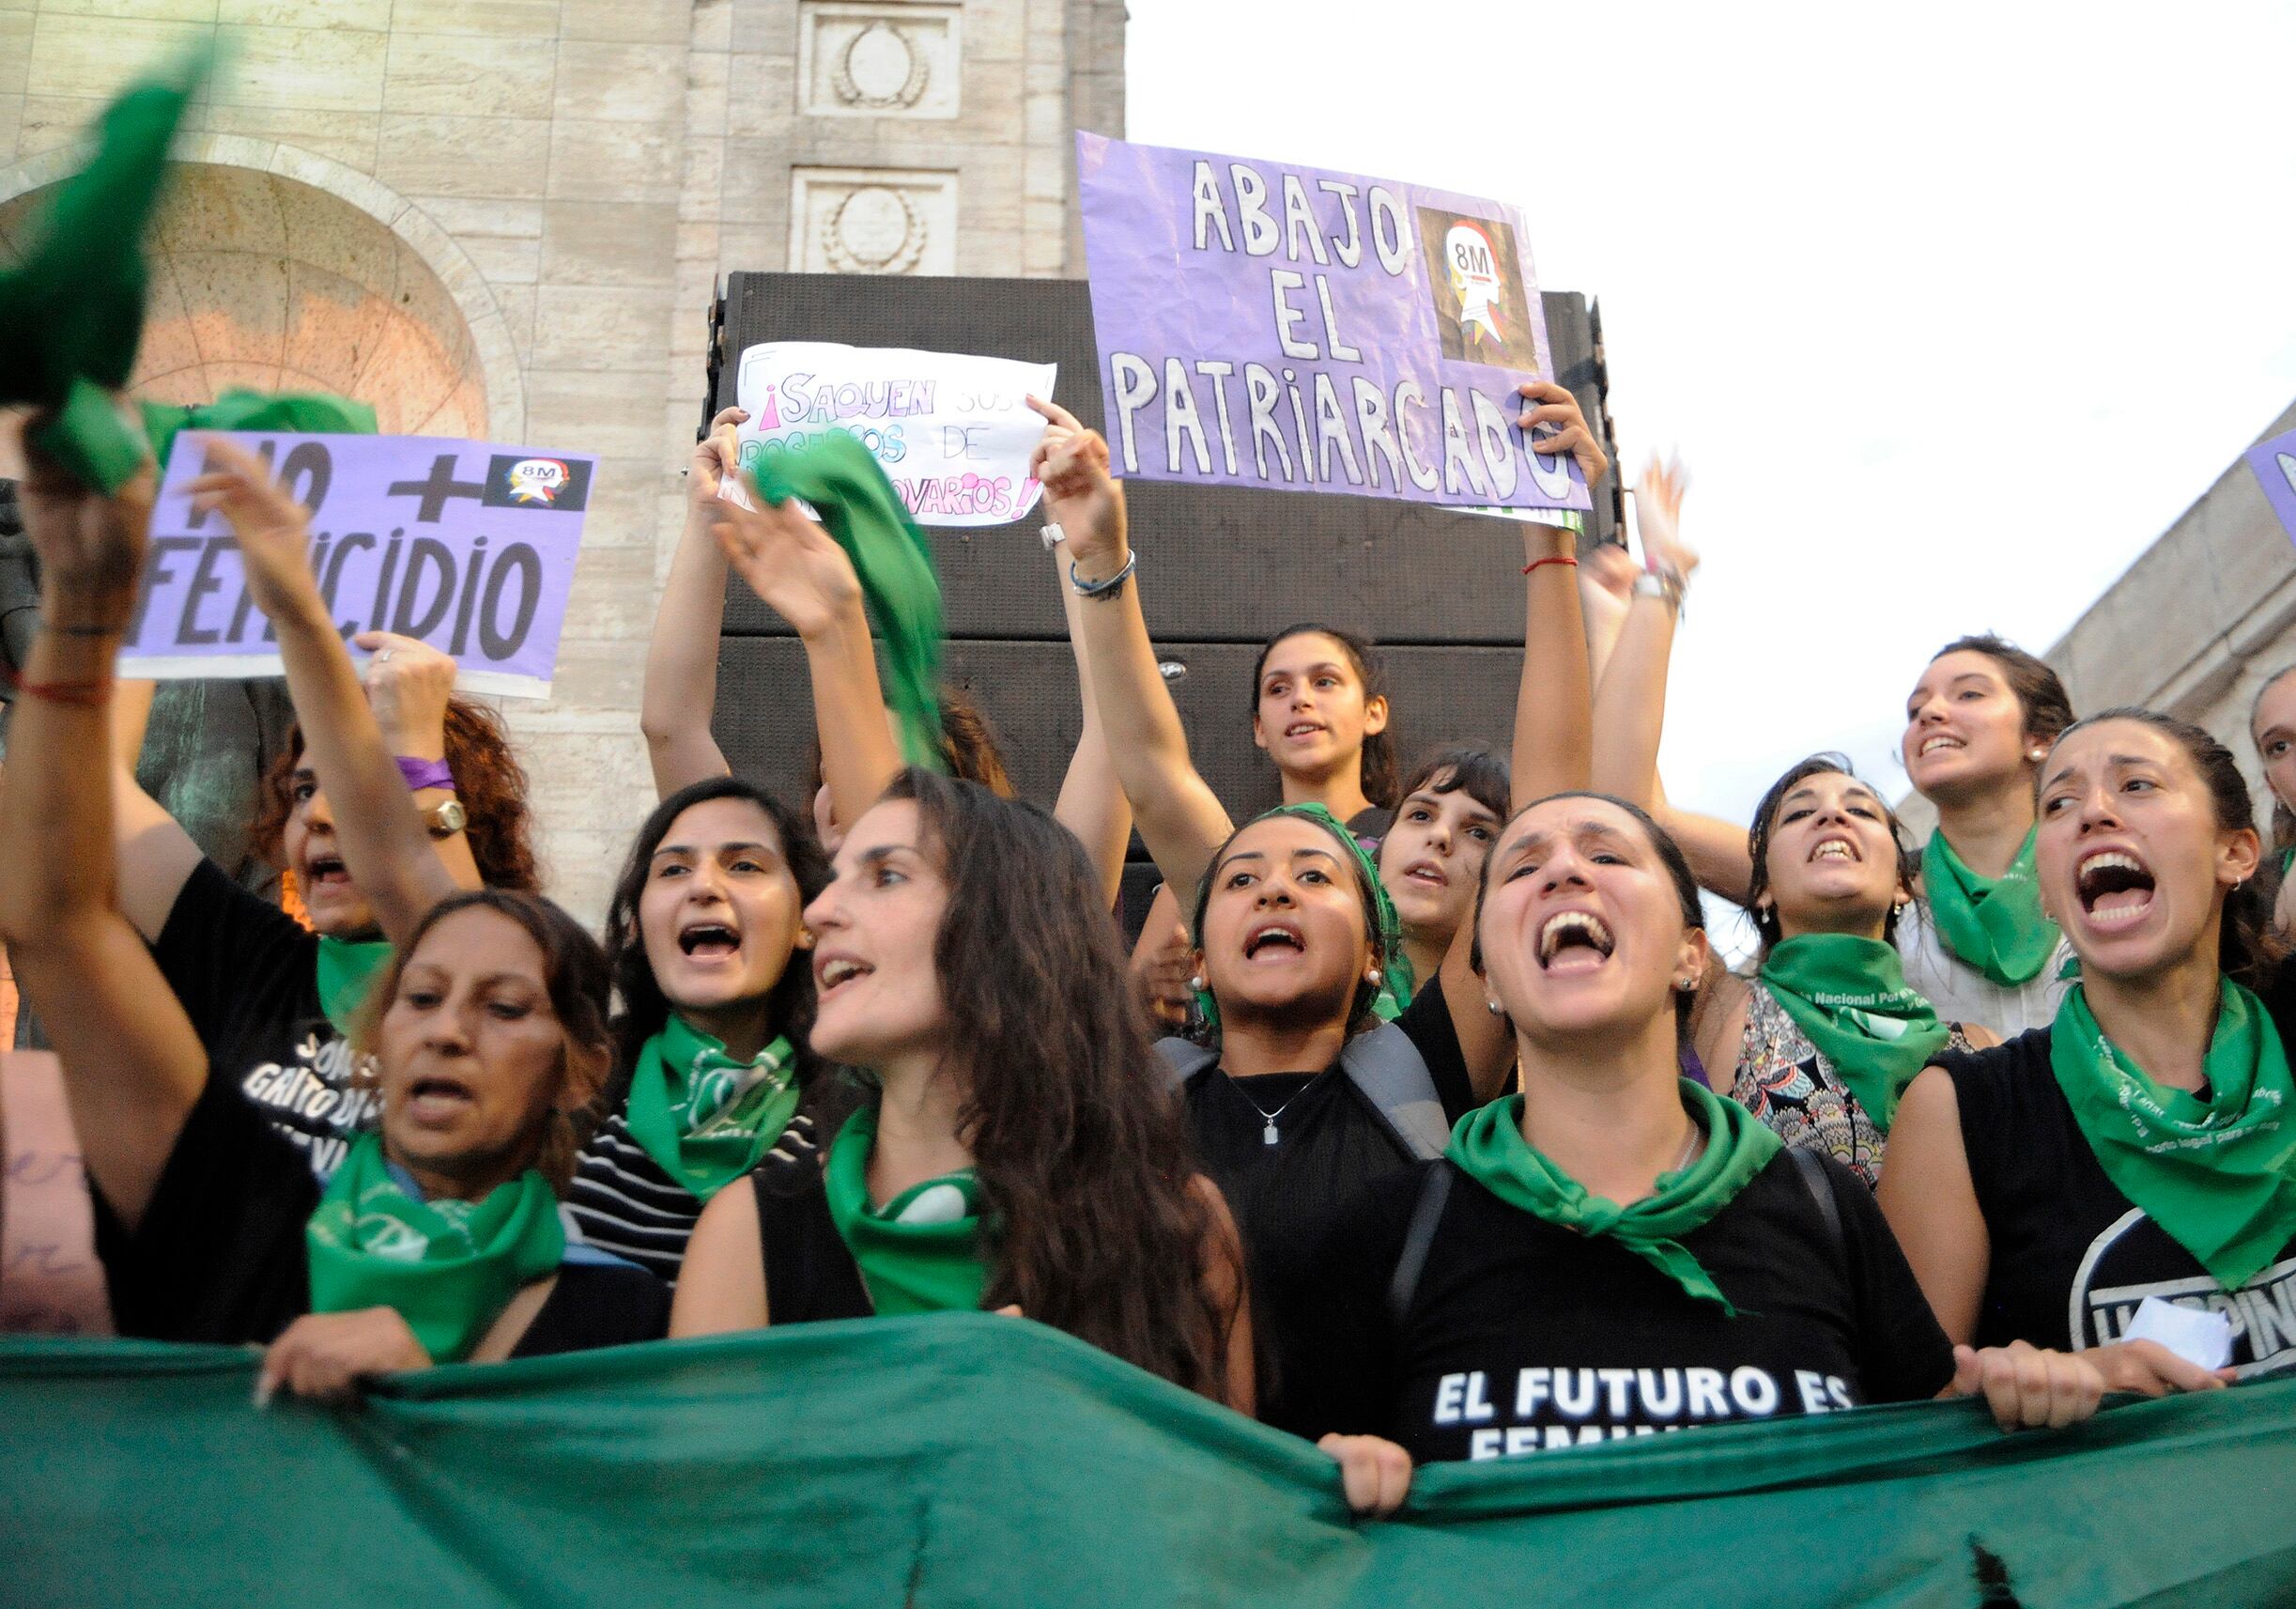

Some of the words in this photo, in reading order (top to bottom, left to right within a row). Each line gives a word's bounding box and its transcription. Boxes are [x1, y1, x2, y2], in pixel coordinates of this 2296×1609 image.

[1193, 159, 1409, 277] ABAJO
[1456, 242, 1489, 275] 8M
[1270, 267, 1364, 364] EL
[943, 425, 991, 461] DE
[522, 466, 557, 478] 8M
[1814, 991, 1875, 1006] Nacional
[241, 1062, 341, 1119] GRITO
[1433, 1370, 1494, 1423] EL
[1516, 1365, 1778, 1417] FUTURO
[1794, 1369, 1854, 1414] ES
